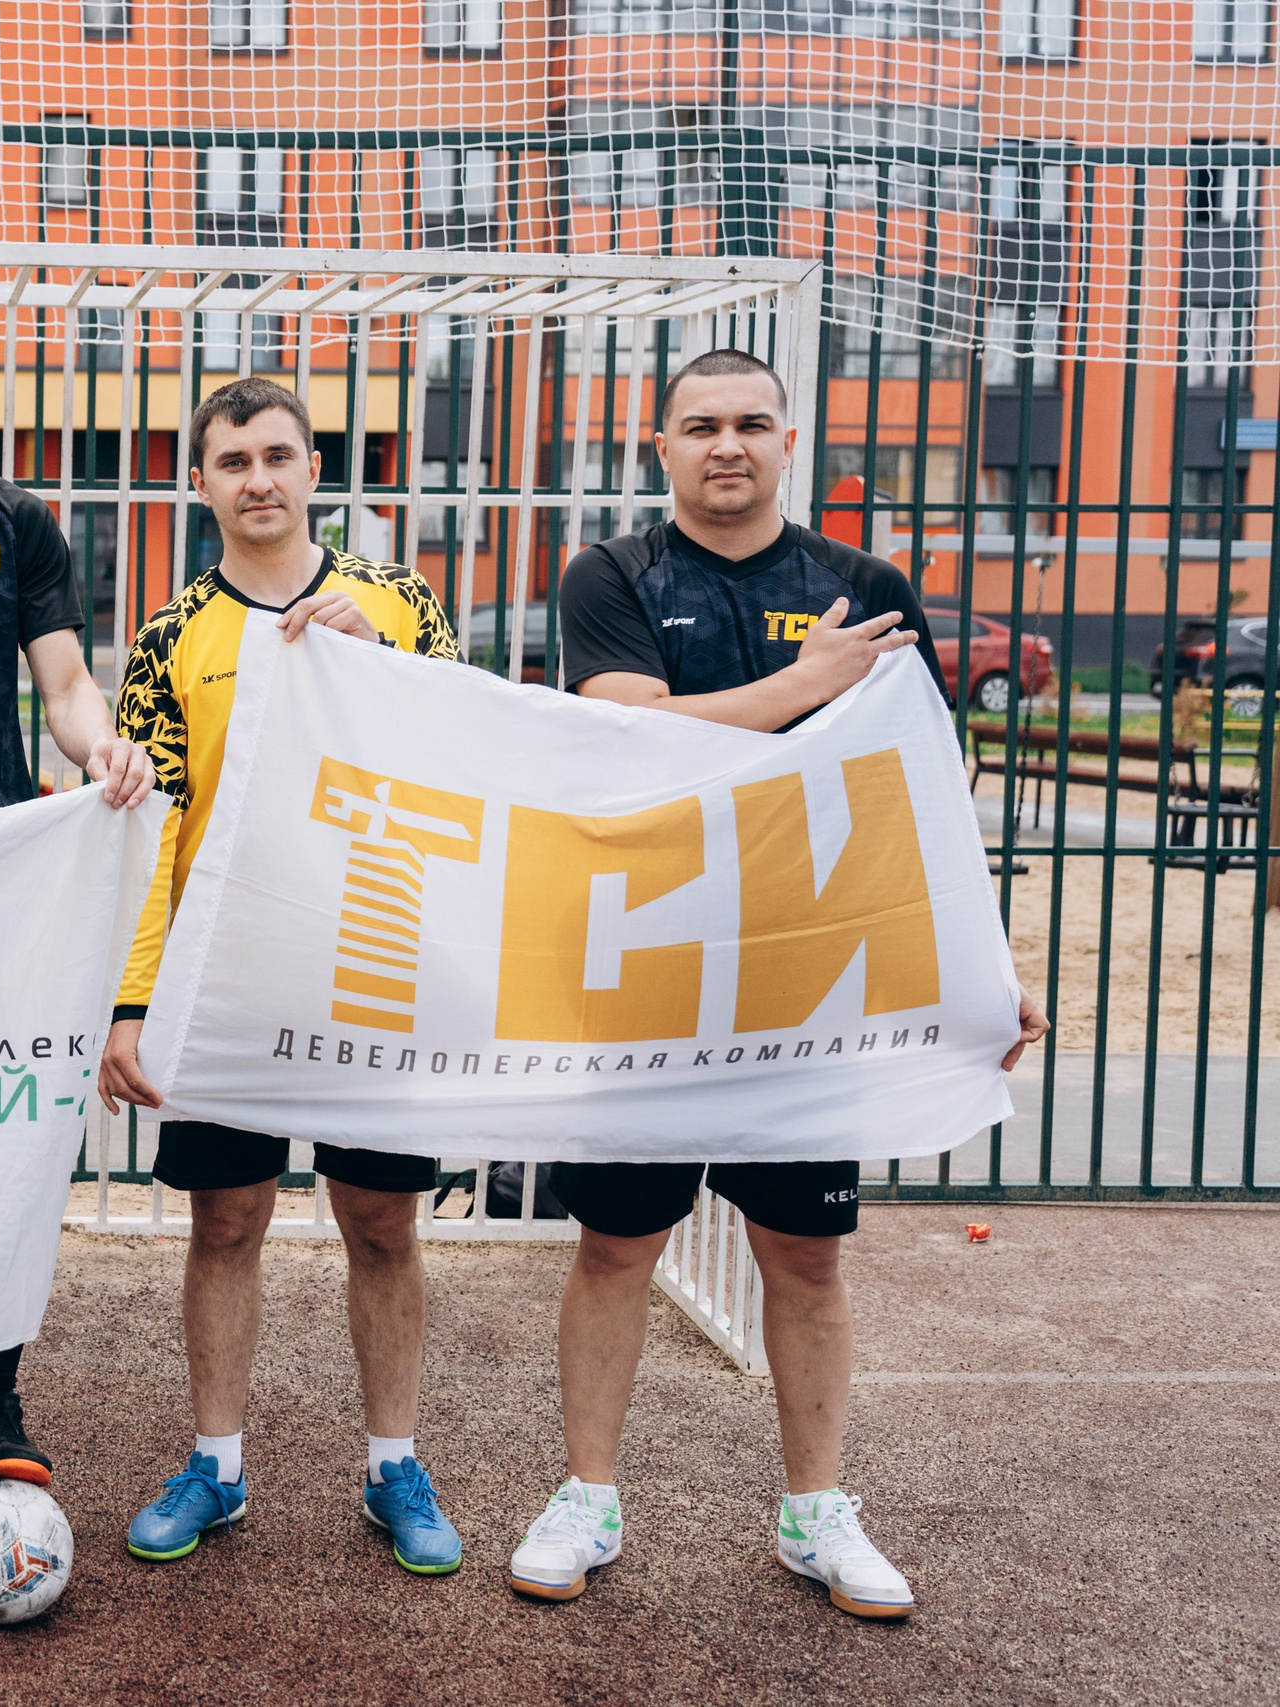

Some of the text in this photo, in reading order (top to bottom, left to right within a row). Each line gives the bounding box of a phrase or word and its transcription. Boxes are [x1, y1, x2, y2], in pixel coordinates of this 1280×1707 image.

[673, 616, 697, 626] SPORT
[215, 670, 238, 682] SPOR
[308, 746, 941, 1044] ТСИ
[272, 1023, 942, 1076] ДЕВЕЛОПЕРСКАЯ КОМПАНИЯ
[824, 1188, 859, 1203] KEL
